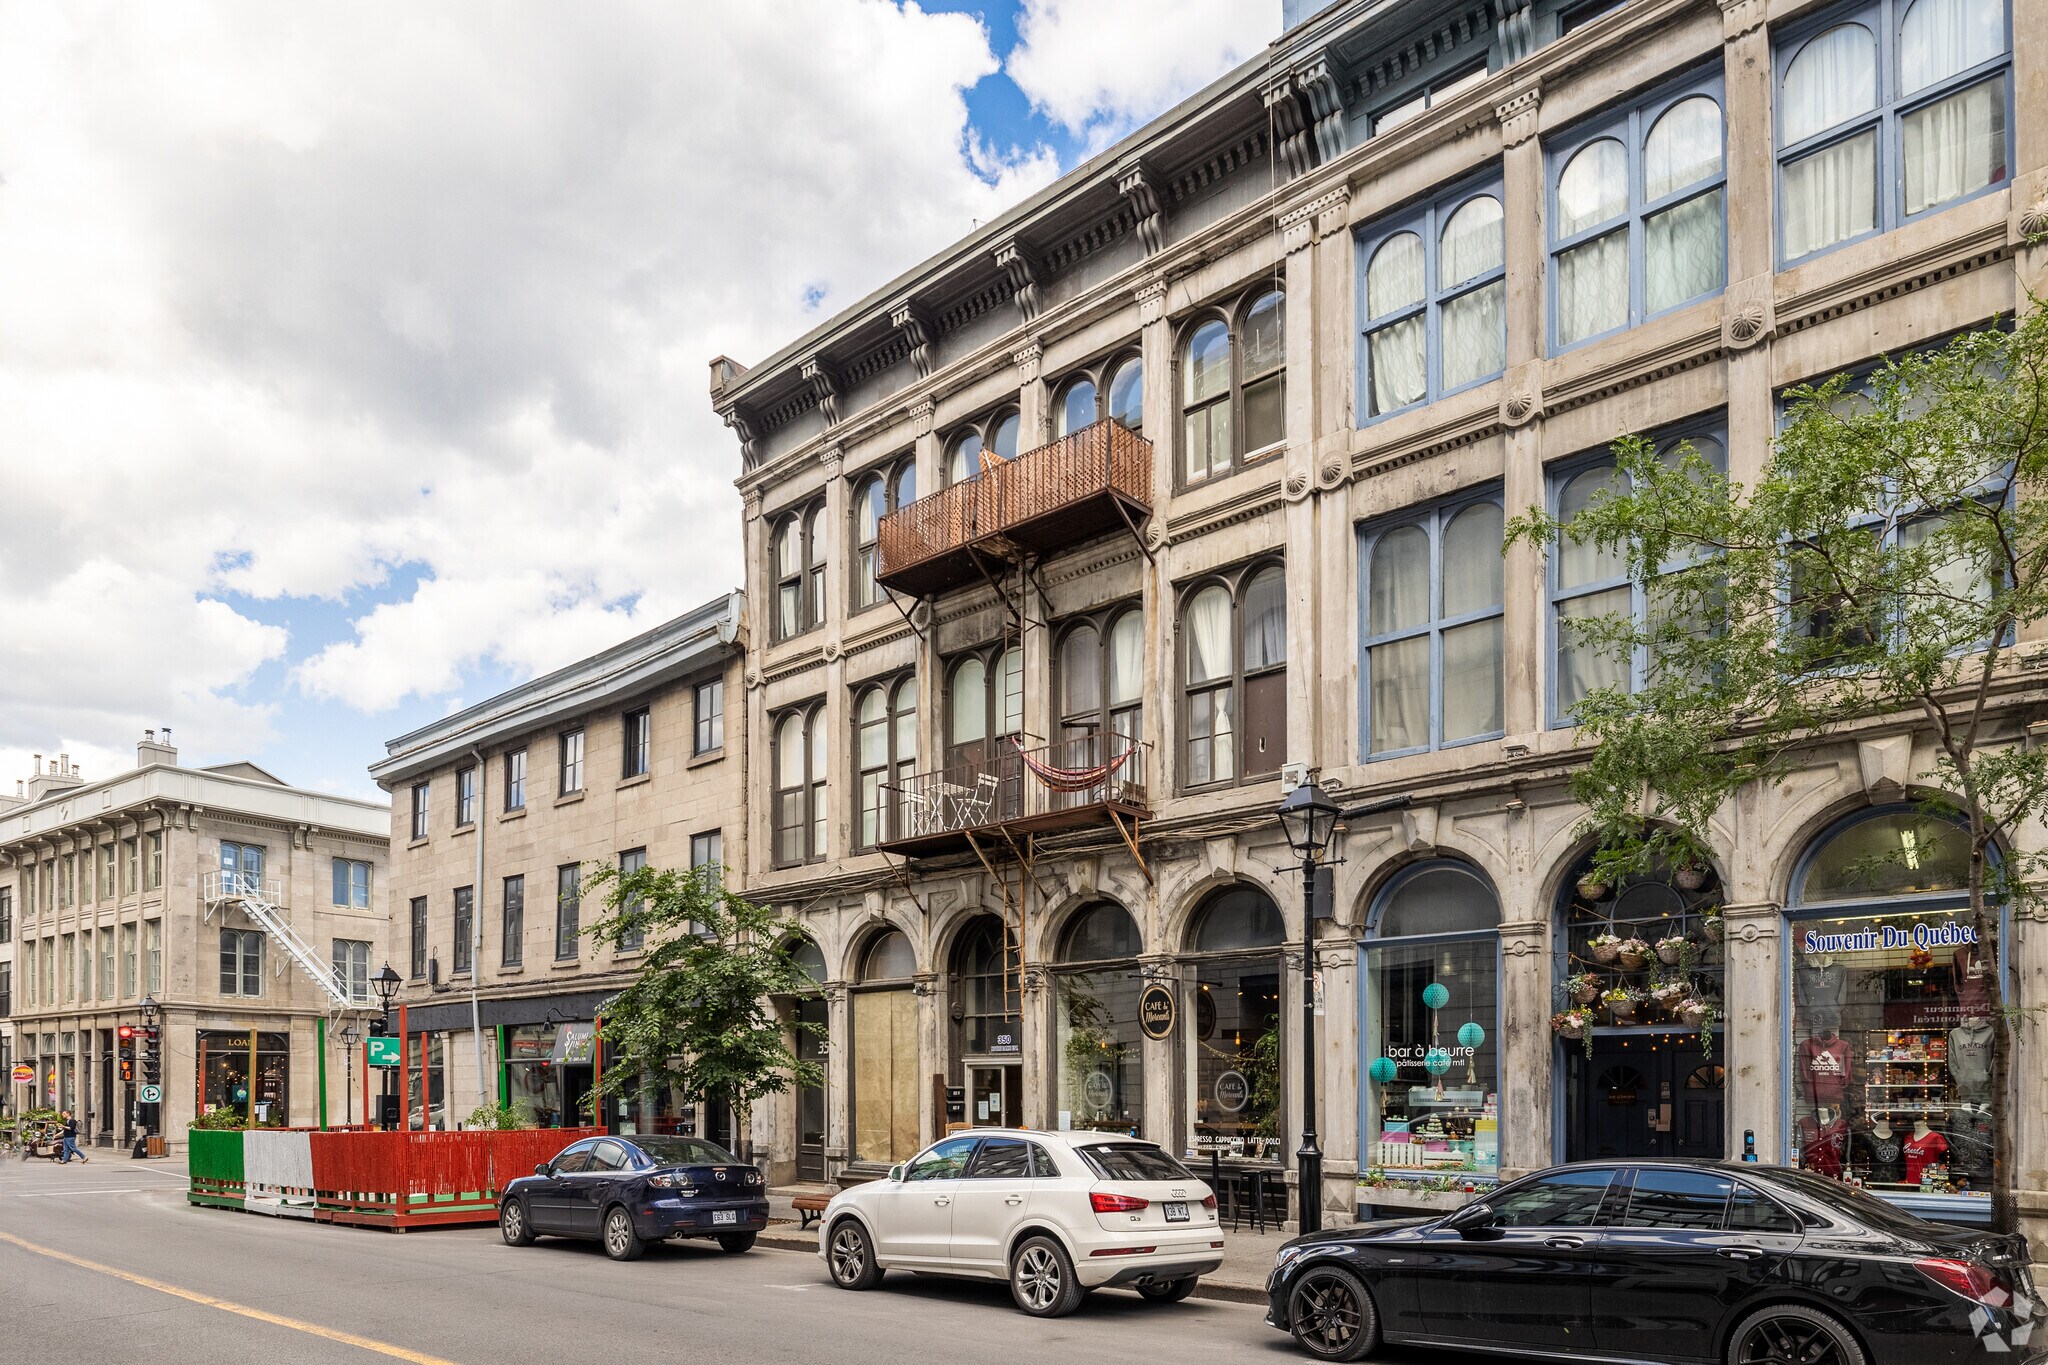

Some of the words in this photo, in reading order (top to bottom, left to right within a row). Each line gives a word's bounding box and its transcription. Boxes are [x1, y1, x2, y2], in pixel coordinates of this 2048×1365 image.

[1805, 926, 1878, 954] Souvenir
[1882, 925, 1909, 949] Du
[1145, 1001, 1162, 1010] CAFÉ
[997, 1035, 1011, 1044] 350
[370, 1041, 385, 1056] P
[1388, 1045, 1412, 1057] bar
[1415, 1044, 1425, 1057] à
[1428, 1044, 1475, 1057] beurre
[1396, 1059, 1431, 1067] pâtisserie
[1219, 1082, 1236, 1090] CAFÉ
[1189, 1135, 1213, 1143] ESPRESSO
[1215, 1136, 1244, 1144] CAPPUCCINO
[1265, 1137, 1280, 1145] DOLCI
